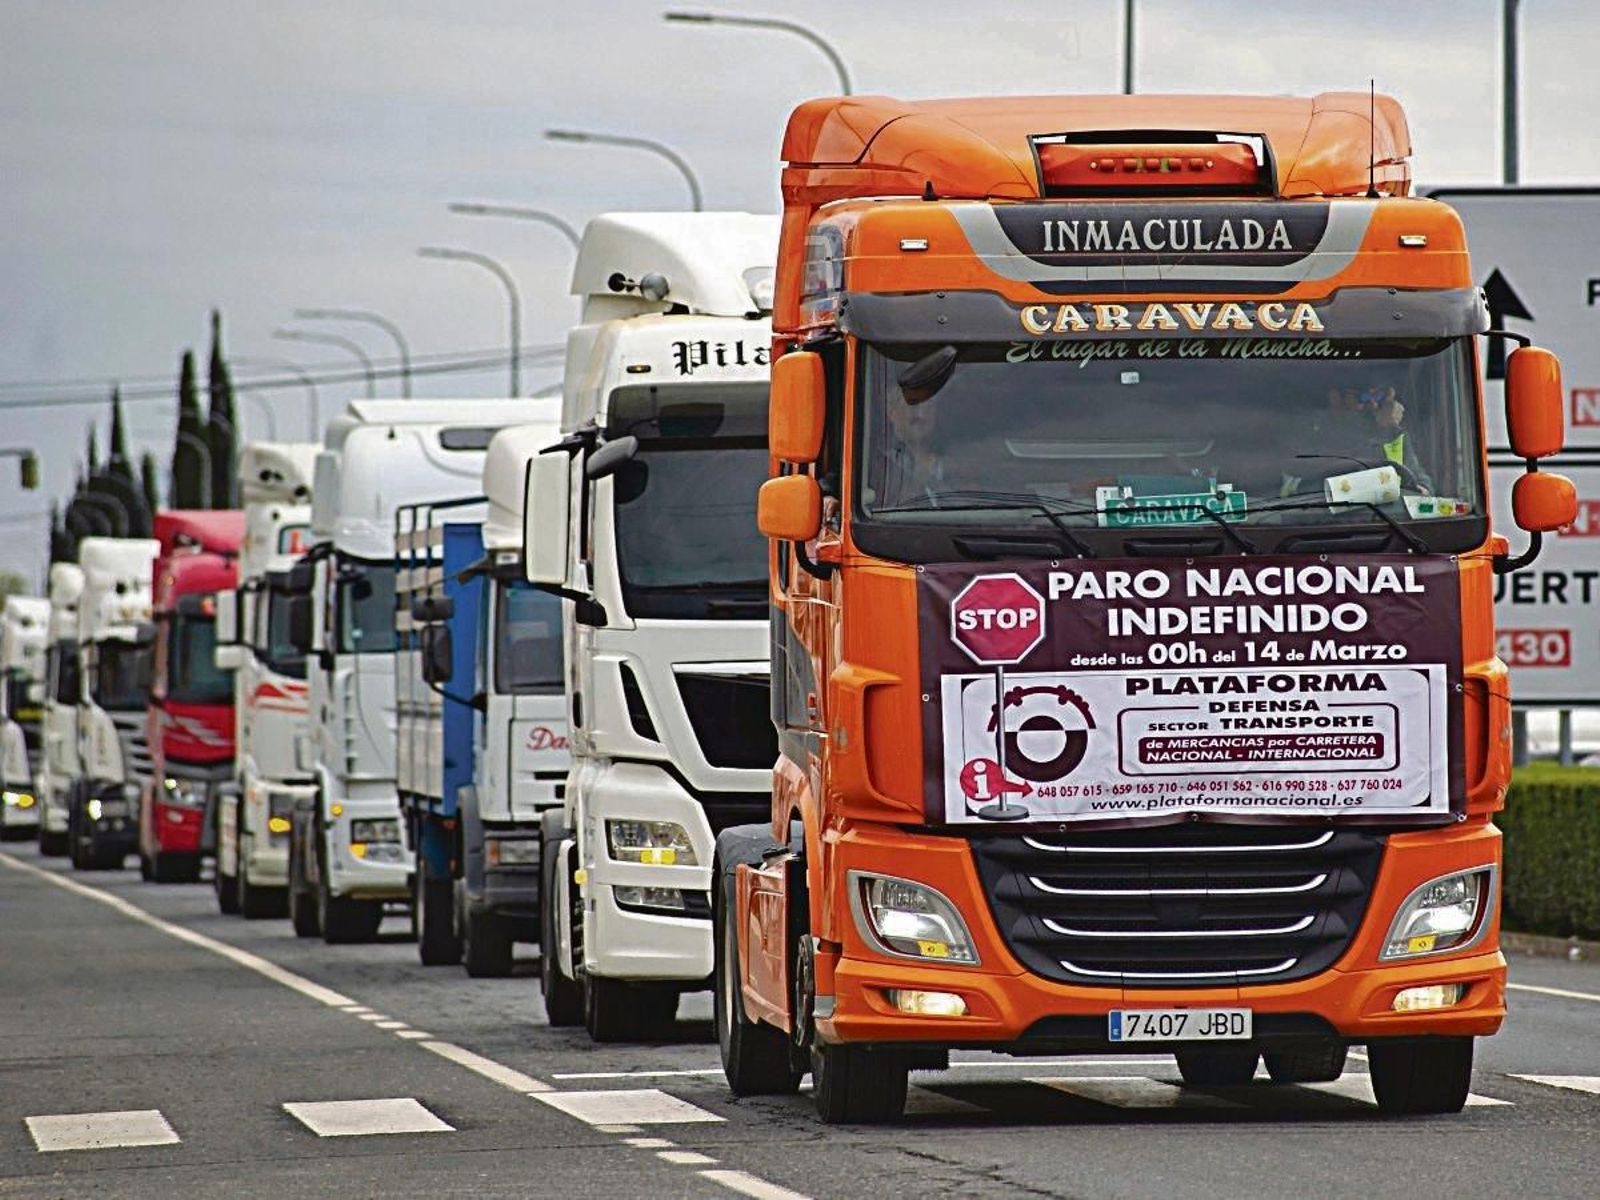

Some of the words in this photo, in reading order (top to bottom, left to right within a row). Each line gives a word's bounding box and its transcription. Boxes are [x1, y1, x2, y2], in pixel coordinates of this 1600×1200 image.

[1043, 218, 1293, 251] INMACULADA
[1020, 302, 1326, 336] CARAVACA
[1006, 339, 1043, 363] El
[1051, 338, 1130, 369] lugar
[1138, 338, 1174, 359] de
[1178, 338, 1210, 358] la
[1048, 569, 1170, 600] PARO
[1186, 565, 1425, 597] NACIONAL
[958, 608, 1038, 631] STOP
[1107, 602, 1368, 636] INDEFINIDO
[1070, 653, 1117, 667] desde
[1121, 653, 1143, 665] las
[1147, 641, 1207, 665] 00h
[1212, 650, 1236, 663] del
[1244, 641, 1281, 662] 14
[1286, 648, 1305, 661] de
[1309, 640, 1408, 661] Marzo
[1125, 672, 1388, 696] PLATAFORMA
[1208, 699, 1320, 714] DEFENSA
[1148, 722, 1209, 732] SECTOR
[1219, 715, 1375, 730] TRANSPORTE
[1145, 740, 1164, 749] de
[1167, 737, 1265, 749] MERCANCIAS
[1267, 738, 1293, 749] por
[1295, 735, 1377, 746] CARRETERA
[1146, 750, 1233, 762] NACIONAL
[1247, 747, 1377, 760] INTERNACIONAL
[1037, 787, 1057, 797] 648
[1060, 786, 1079, 796] 057
[1083, 785, 1102, 795] 615
[1112, 784, 1131, 794] 659
[1135, 783, 1154, 793] 165
[1157, 783, 1177, 792] 710
[1187, 782, 1206, 791] 646
[1209, 782, 1228, 791] 051
[1232, 781, 1252, 790] 562
[1262, 781, 1282, 791] 616
[1285, 780, 1305, 790] 990
[1308, 780, 1328, 790] 528
[1337, 780, 1357, 790] 637
[1360, 779, 1380, 790] 760
[1382, 779, 1402, 790] 024
[1091, 794, 1364, 811] www.plataformanacional.es
[1127, 1014, 1188, 1037] 7407
[1199, 1013, 1245, 1035] JBD
